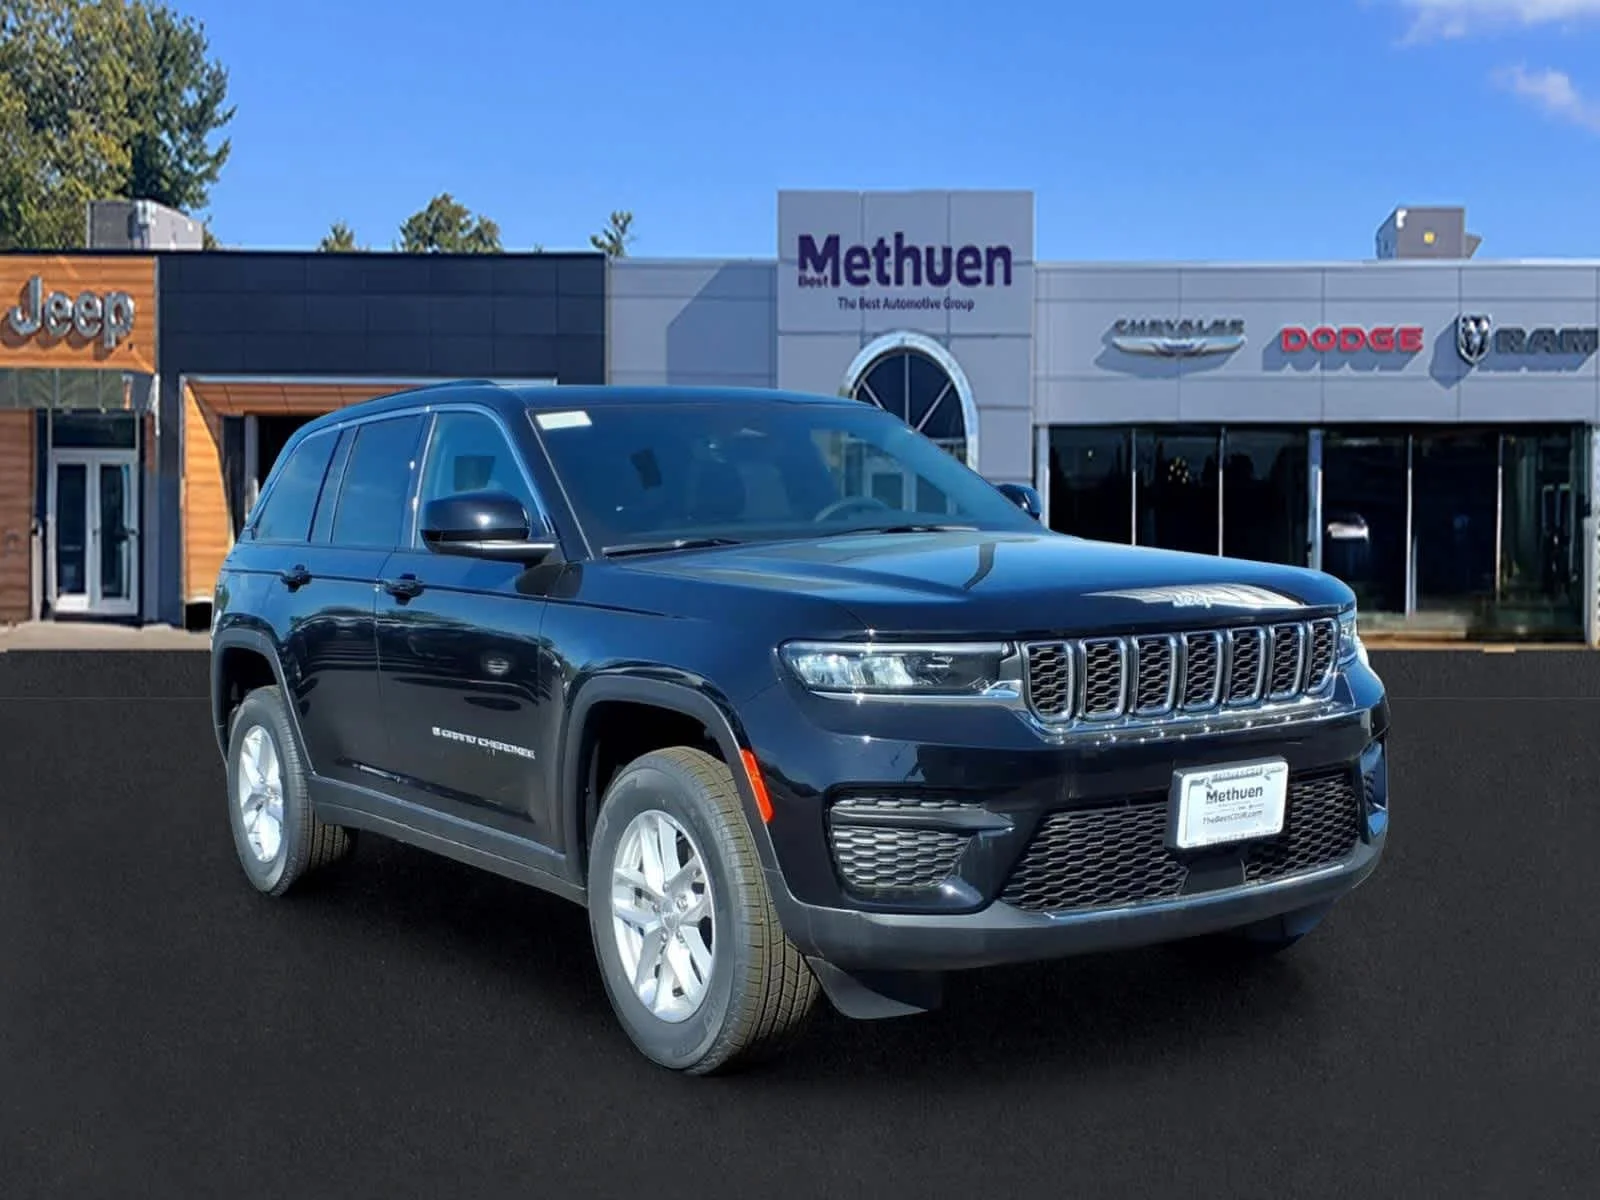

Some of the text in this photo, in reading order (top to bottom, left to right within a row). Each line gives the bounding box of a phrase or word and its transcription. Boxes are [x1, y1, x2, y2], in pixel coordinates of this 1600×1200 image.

[798, 231, 1012, 287] Methuen
[9, 275, 135, 349] Jeep
[838, 297, 975, 312] The Best Automotive Group
[1281, 327, 1424, 351] DODGE
[1495, 327, 1600, 352] RAM
[1206, 786, 1263, 803] Methuen
